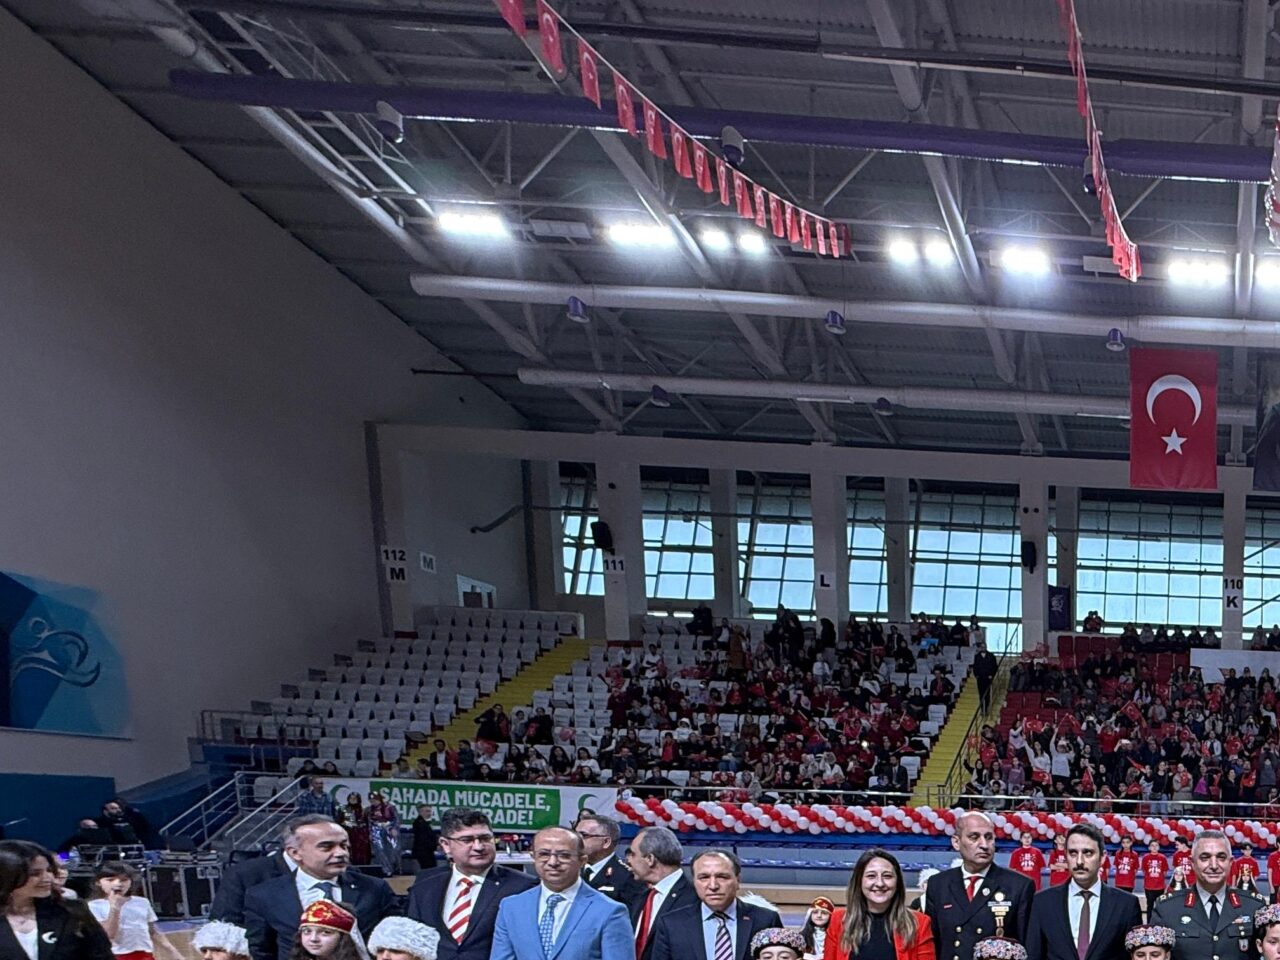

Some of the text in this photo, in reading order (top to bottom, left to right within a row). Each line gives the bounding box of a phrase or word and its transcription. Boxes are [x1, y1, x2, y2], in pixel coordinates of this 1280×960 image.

[383, 549, 406, 561] 112
[422, 555, 434, 570] M
[604, 559, 624, 571] 111
[390, 567, 405, 581] M
[820, 574, 830, 587] L
[1224, 579, 1243, 590] 110
[1226, 595, 1238, 608] K
[380, 786, 451, 806] SAHADA
[476, 808, 534, 826] RADE!
